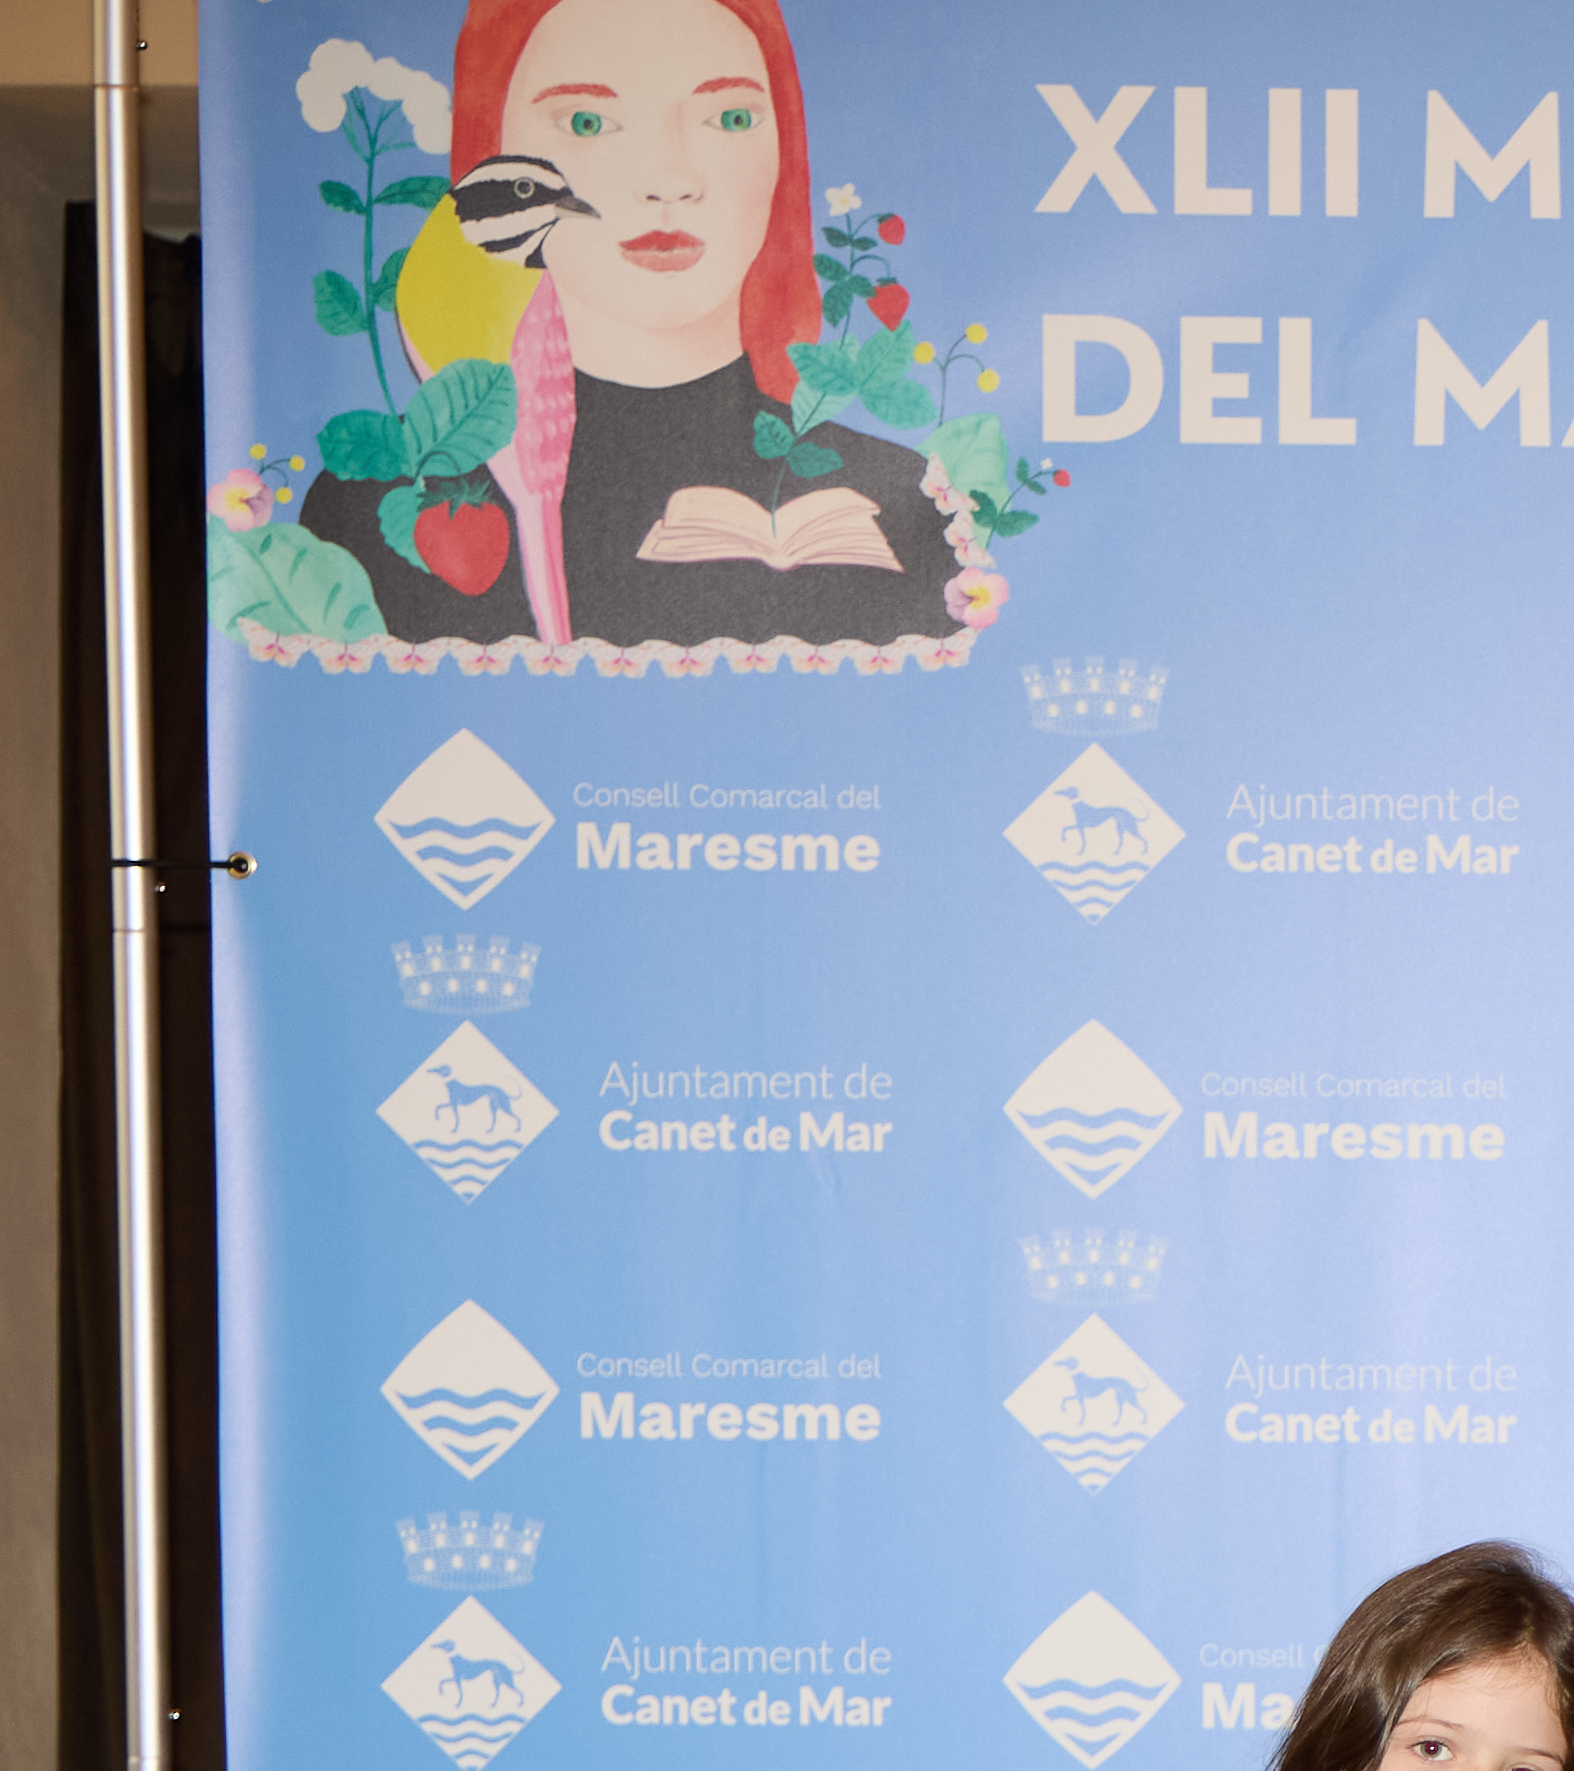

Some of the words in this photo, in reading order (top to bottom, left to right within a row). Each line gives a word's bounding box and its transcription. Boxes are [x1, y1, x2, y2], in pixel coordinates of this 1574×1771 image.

[1036, 84, 1359, 217] XLII
[1042, 313, 1356, 445] DEL
[573, 782, 680, 808] Consell
[689, 783, 829, 810] Comarcal
[837, 785, 881, 810] del
[1227, 784, 1460, 828] Ajuntament
[1472, 786, 1519, 821] de
[577, 822, 880, 872] Maresme
[1227, 832, 1362, 873] Canet
[1370, 839, 1418, 873] de
[1427, 834, 1519, 874] Mar
[600, 1062, 834, 1105] Ajuntament
[844, 1063, 893, 1100] de
[1201, 1072, 1306, 1097] Consell
[1316, 1073, 1453, 1099] Comarcal
[1462, 1074, 1506, 1098] del
[600, 1110, 736, 1151] Canet
[743, 1116, 791, 1151] de
[800, 1112, 893, 1151] Mar
[1205, 1112, 1505, 1160] Maresme
[577, 1351, 684, 1378] Consell
[691, 1352, 831, 1379] Comarcal
[837, 1354, 881, 1379] del
[1226, 1354, 1458, 1398] Ajuntament
[1469, 1356, 1517, 1392] de
[581, 1392, 881, 1441] Maresme
[1225, 1402, 1360, 1443] Canet
[1368, 1409, 1415, 1443] de
[1425, 1404, 1517, 1443] Mar
[602, 1636, 833, 1680] Ajuntament
[843, 1637, 892, 1675] de
[1200, 1643, 1305, 1669] Consell
[602, 1684, 736, 1725] Canet
[744, 1691, 791, 1725] de
[800, 1686, 892, 1726] Mar
